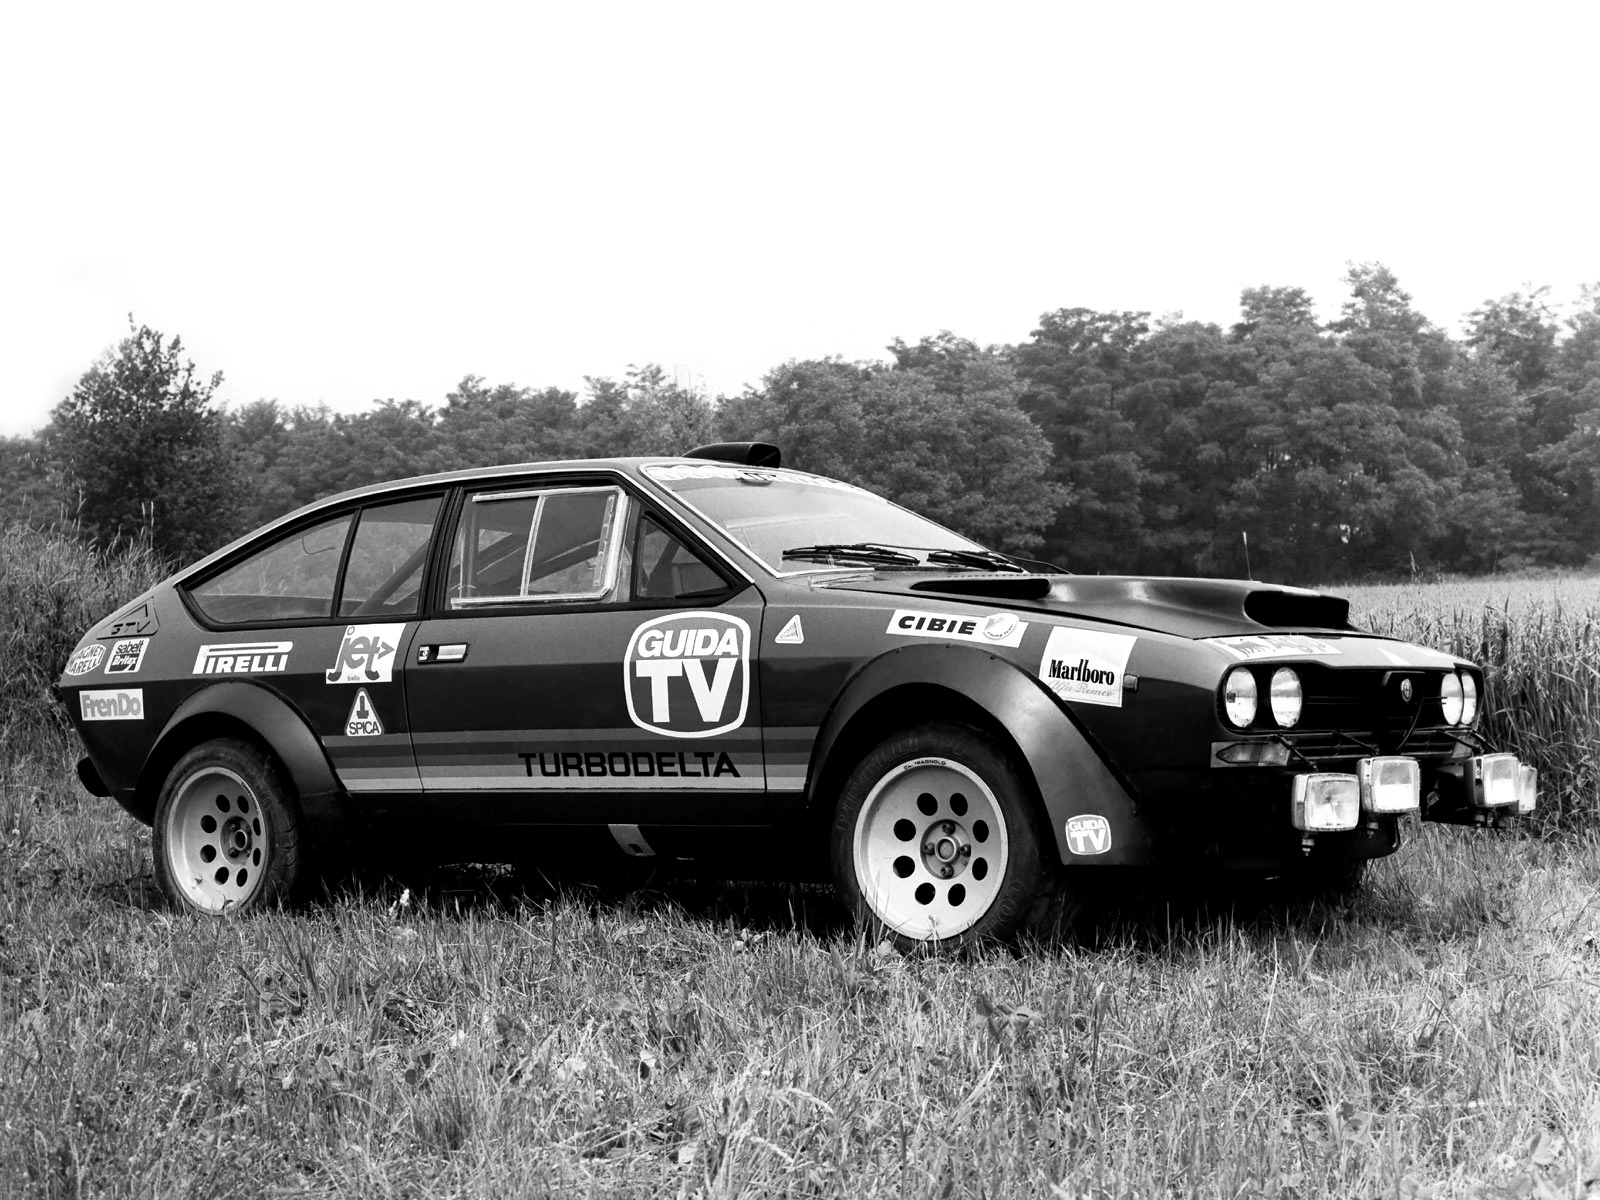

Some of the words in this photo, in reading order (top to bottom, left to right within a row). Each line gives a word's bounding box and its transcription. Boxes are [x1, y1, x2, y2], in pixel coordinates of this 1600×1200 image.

[116, 639, 144, 654] sabelt
[637, 628, 739, 658] GUIDA
[192, 641, 294, 675] PIRELLI
[1048, 658, 1115, 686] Marlboro
[635, 657, 738, 723] TV
[82, 692, 141, 718] FrenDo
[349, 721, 380, 735] SPICA
[518, 751, 742, 778] TURBODELTA
[1068, 819, 1106, 831] GUIDA
[1070, 830, 1107, 852] TV
